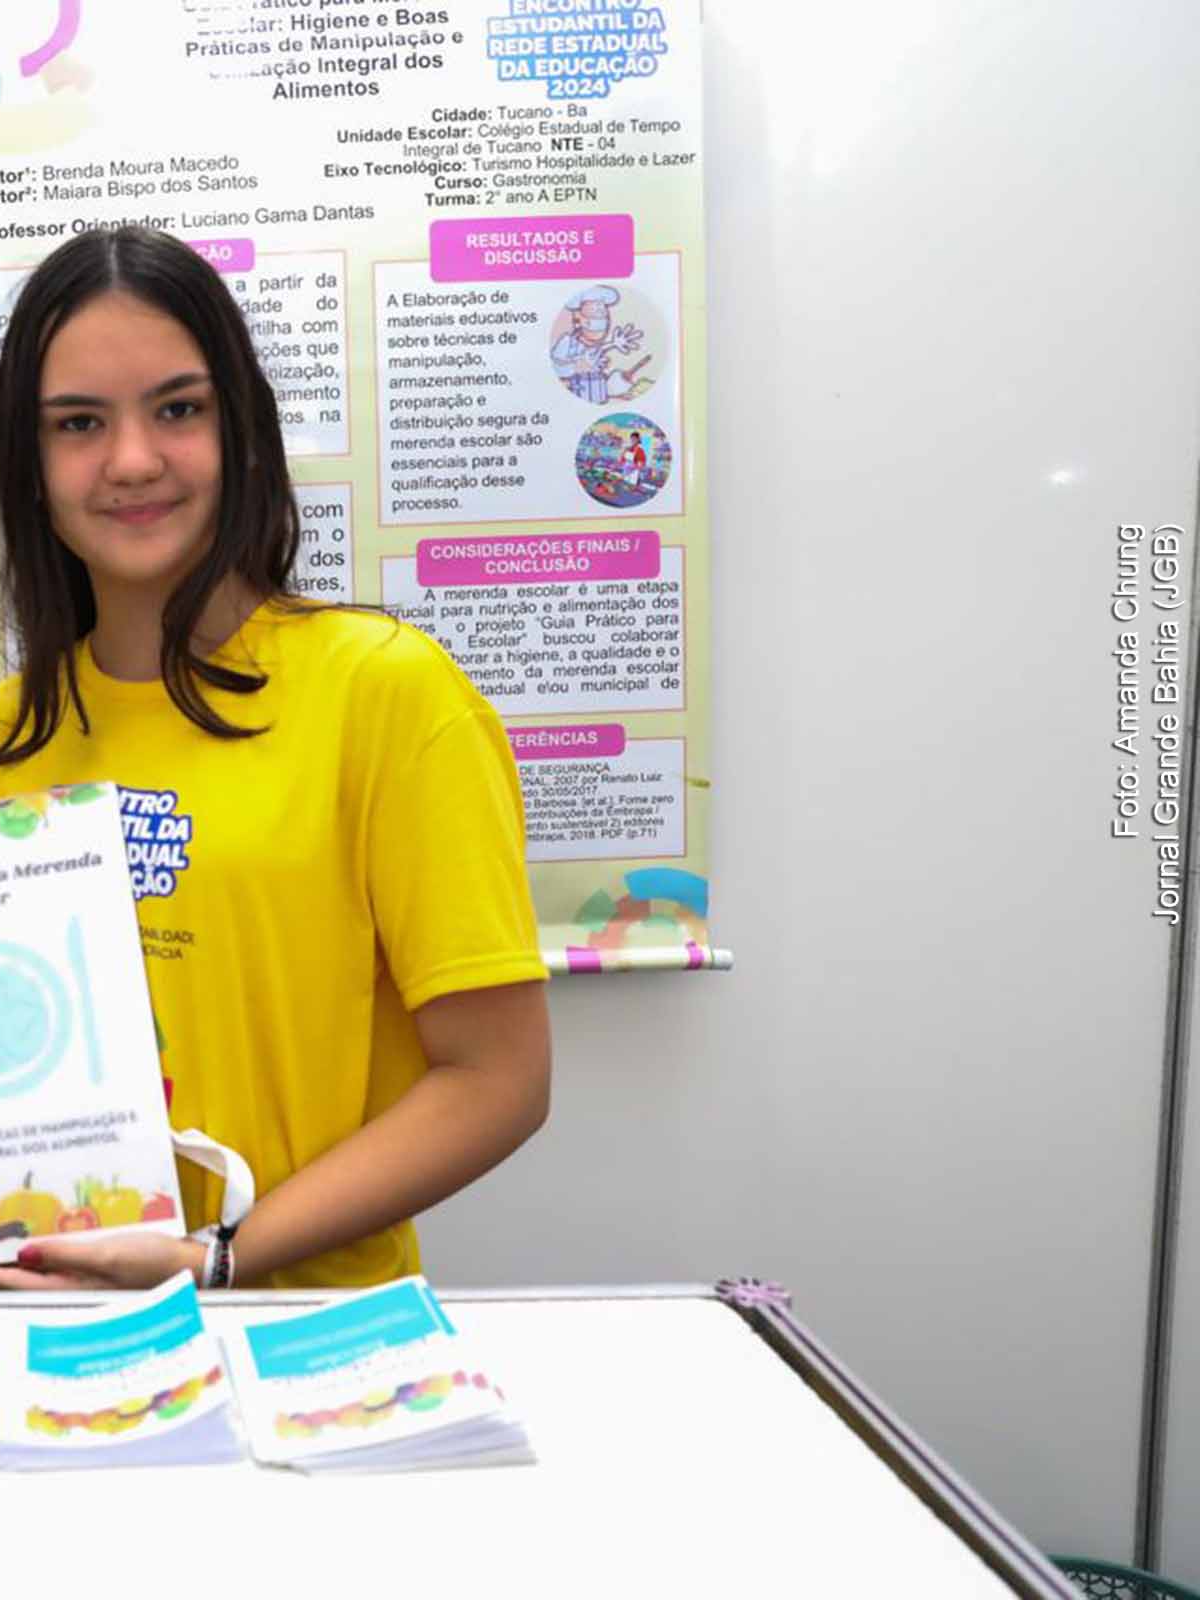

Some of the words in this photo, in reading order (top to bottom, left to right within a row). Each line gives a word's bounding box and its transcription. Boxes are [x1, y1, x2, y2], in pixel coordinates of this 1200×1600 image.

[291, 12, 369, 34] Higiene
[377, 14, 388, 26] e
[396, 9, 449, 25] Boas
[490, 13, 628, 34] ESTUDANTIL
[632, 11, 664, 29] DA
[185, 40, 271, 56] Práticas
[278, 38, 302, 52] de
[310, 30, 445, 51] Manipulação
[452, 31, 464, 43] e
[490, 37, 547, 56] REDE
[551, 33, 664, 54] ESTADUAL
[318, 53, 397, 76] Integral
[404, 52, 443, 69] dos
[501, 60, 530, 78] DA
[535, 52, 657, 81] EDUCAÇÃO
[272, 80, 379, 99] Alimentos
[551, 80, 606, 97] 2024
[432, 108, 492, 122] Cidade:
[497, 106, 552, 120] Tucano
[567, 104, 587, 117] Ba
[337, 128, 402, 143] Unidade
[408, 126, 472, 140] Escolar:
[478, 124, 534, 139] Colégio
[539, 120, 602, 135] Estadual
[607, 120, 625, 133] de
[630, 119, 681, 134] Tempo
[403, 143, 459, 159] Integral
[463, 142, 482, 155] de
[486, 140, 542, 154] Tucano
[551, 137, 583, 151] NTE
[598, 137, 616, 150] 04
[42, 163, 104, 181] Brenda
[110, 160, 164, 177] Moura
[170, 155, 239, 172] Macedo
[324, 164, 359, 178] Eixo
[363, 160, 467, 177] Tecnológico:
[472, 157, 532, 171] Turismo
[536, 153, 635, 170] Hospitalidade
[653, 152, 696, 166] Lazer
[43, 184, 102, 201] Maiara
[107, 180, 156, 198] Bispo
[161, 178, 192, 193] dos
[197, 175, 258, 191] Santos
[434, 176, 488, 189] Curso:
[492, 173, 586, 187] Gastronomia
[425, 192, 481, 207] Turma:
[506, 191, 534, 203] ano
[554, 187, 597, 202] EPTN
[181, 211, 249, 228] Luciano
[255, 207, 308, 225] Gama
[313, 204, 375, 221] Dantas
[467, 232, 579, 248] RESULTADOS
[584, 231, 594, 244] E
[485, 248, 581, 265] DISCUSSÃO
[259, 275, 304, 294] partir
[315, 273, 337, 288] da
[316, 296, 338, 311] do
[403, 291, 486, 307] Elaboração
[491, 290, 509, 304] de
[302, 321, 338, 334] com
[387, 314, 455, 328] materiais
[459, 311, 538, 326] educativos
[388, 335, 429, 349] sobre
[433, 333, 494, 346] técnicas
[498, 330, 517, 344] de
[307, 342, 339, 359] que
[388, 352, 486, 369] manipulação,
[389, 373, 512, 389] armazenamento,
[390, 394, 473, 411] preparação
[319, 410, 341, 423] na
[390, 413, 473, 430] distribuição
[477, 413, 527, 430] segura
[530, 411, 549, 425] da
[391, 435, 455, 450] merenda
[460, 434, 512, 447] escolar
[516, 433, 543, 446] são
[391, 455, 468, 470] essenciais
[471, 456, 504, 469] para
[391, 475, 478, 491] qualificação
[481, 475, 525, 488] desse
[302, 503, 343, 519] com
[431, 540, 573, 559] CONSIDERAÇÕES
[578, 539, 631, 554] FINAIS
[310, 551, 345, 567] dos
[485, 557, 590, 575] CONCLUSÃO
[444, 587, 508, 600] merenda
[517, 585, 569, 597] escolar
[597, 583, 628, 595] uma
[637, 581, 679, 595] etapa
[441, 606, 473, 619] para
[479, 602, 537, 618] nutrição
[558, 597, 646, 613] alimentação
[652, 597, 679, 608] dos
[476, 620, 525, 634] projeto
[586, 614, 636, 627] Prático
[646, 614, 679, 626] para
[543, 634, 595, 646] buscou
[611, 629, 679, 643] colaborar
[507, 650, 564, 665] higiene,
[581, 646, 650, 662] qualidade
[524, 666, 543, 678] da
[553, 663, 616, 677] merenda
[627, 661, 679, 674] escolar
[581, 678, 649, 692] municipal
[660, 677, 680, 689] de
[510, 731, 599, 747] FERÊNCIAS
[157, 818, 190, 841] DA
[12, 851, 103, 880] Merenda
